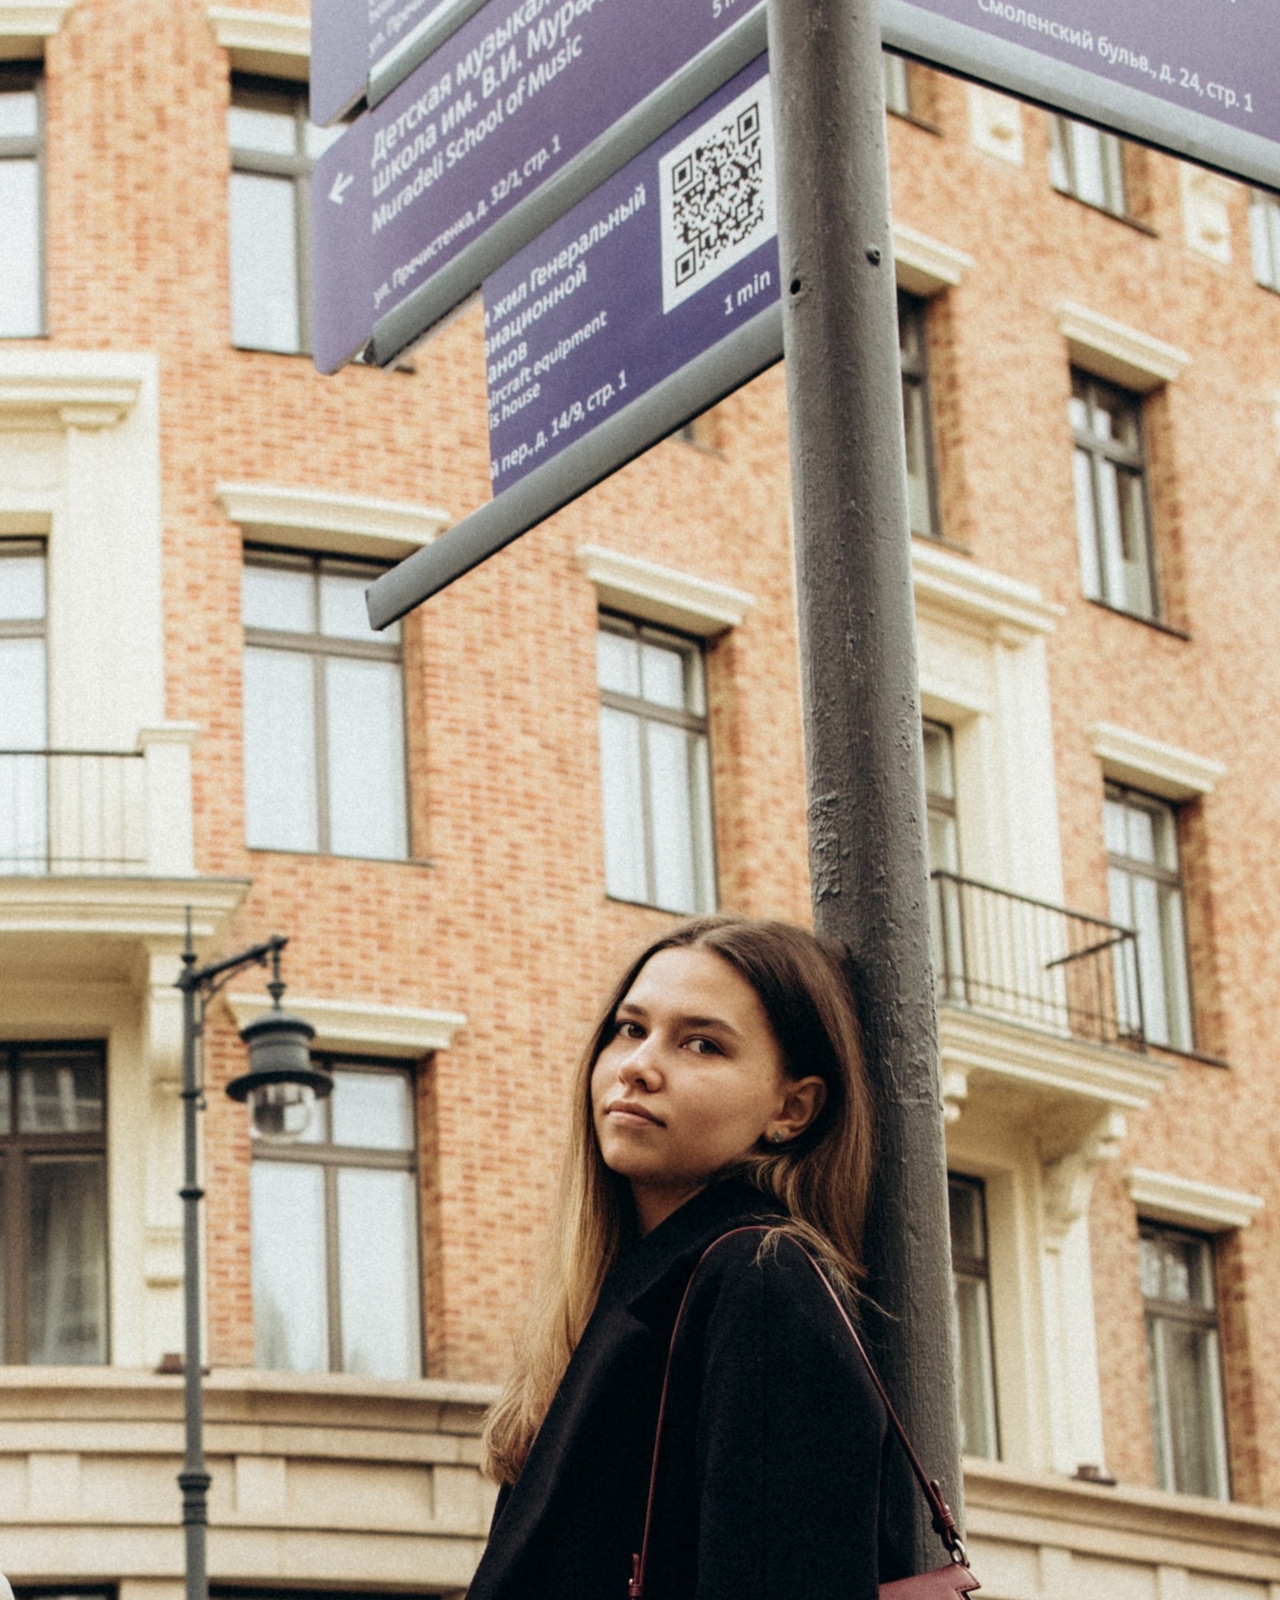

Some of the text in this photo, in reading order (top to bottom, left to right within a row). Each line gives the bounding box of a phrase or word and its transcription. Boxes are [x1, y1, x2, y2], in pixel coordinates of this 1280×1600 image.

[372, 123, 437, 197] школа
[441, 90, 478, 136] им.
[527, 0, 602, 59] Мура
[372, 72, 452, 169] Детская
[1159, 64, 1176, 86] д.
[1180, 67, 1205, 97] 24,
[1206, 82, 1240, 109] стр.
[1244, 93, 1254, 113] 1
[372, 34, 583, 235] Muradeli School of Music
[523, 147, 550, 177] стр.
[552, 134, 561, 154] 1
[493, 182, 646, 323] жил Генеральный
[724, 270, 770, 316] 1 min
[533, 310, 608, 376] equipment
[502, 383, 541, 421] house
[534, 430, 548, 453] д.
[551, 401, 585, 438] 14/9,
[586, 383, 616, 412] стр.
[618, 369, 627, 391] 1
